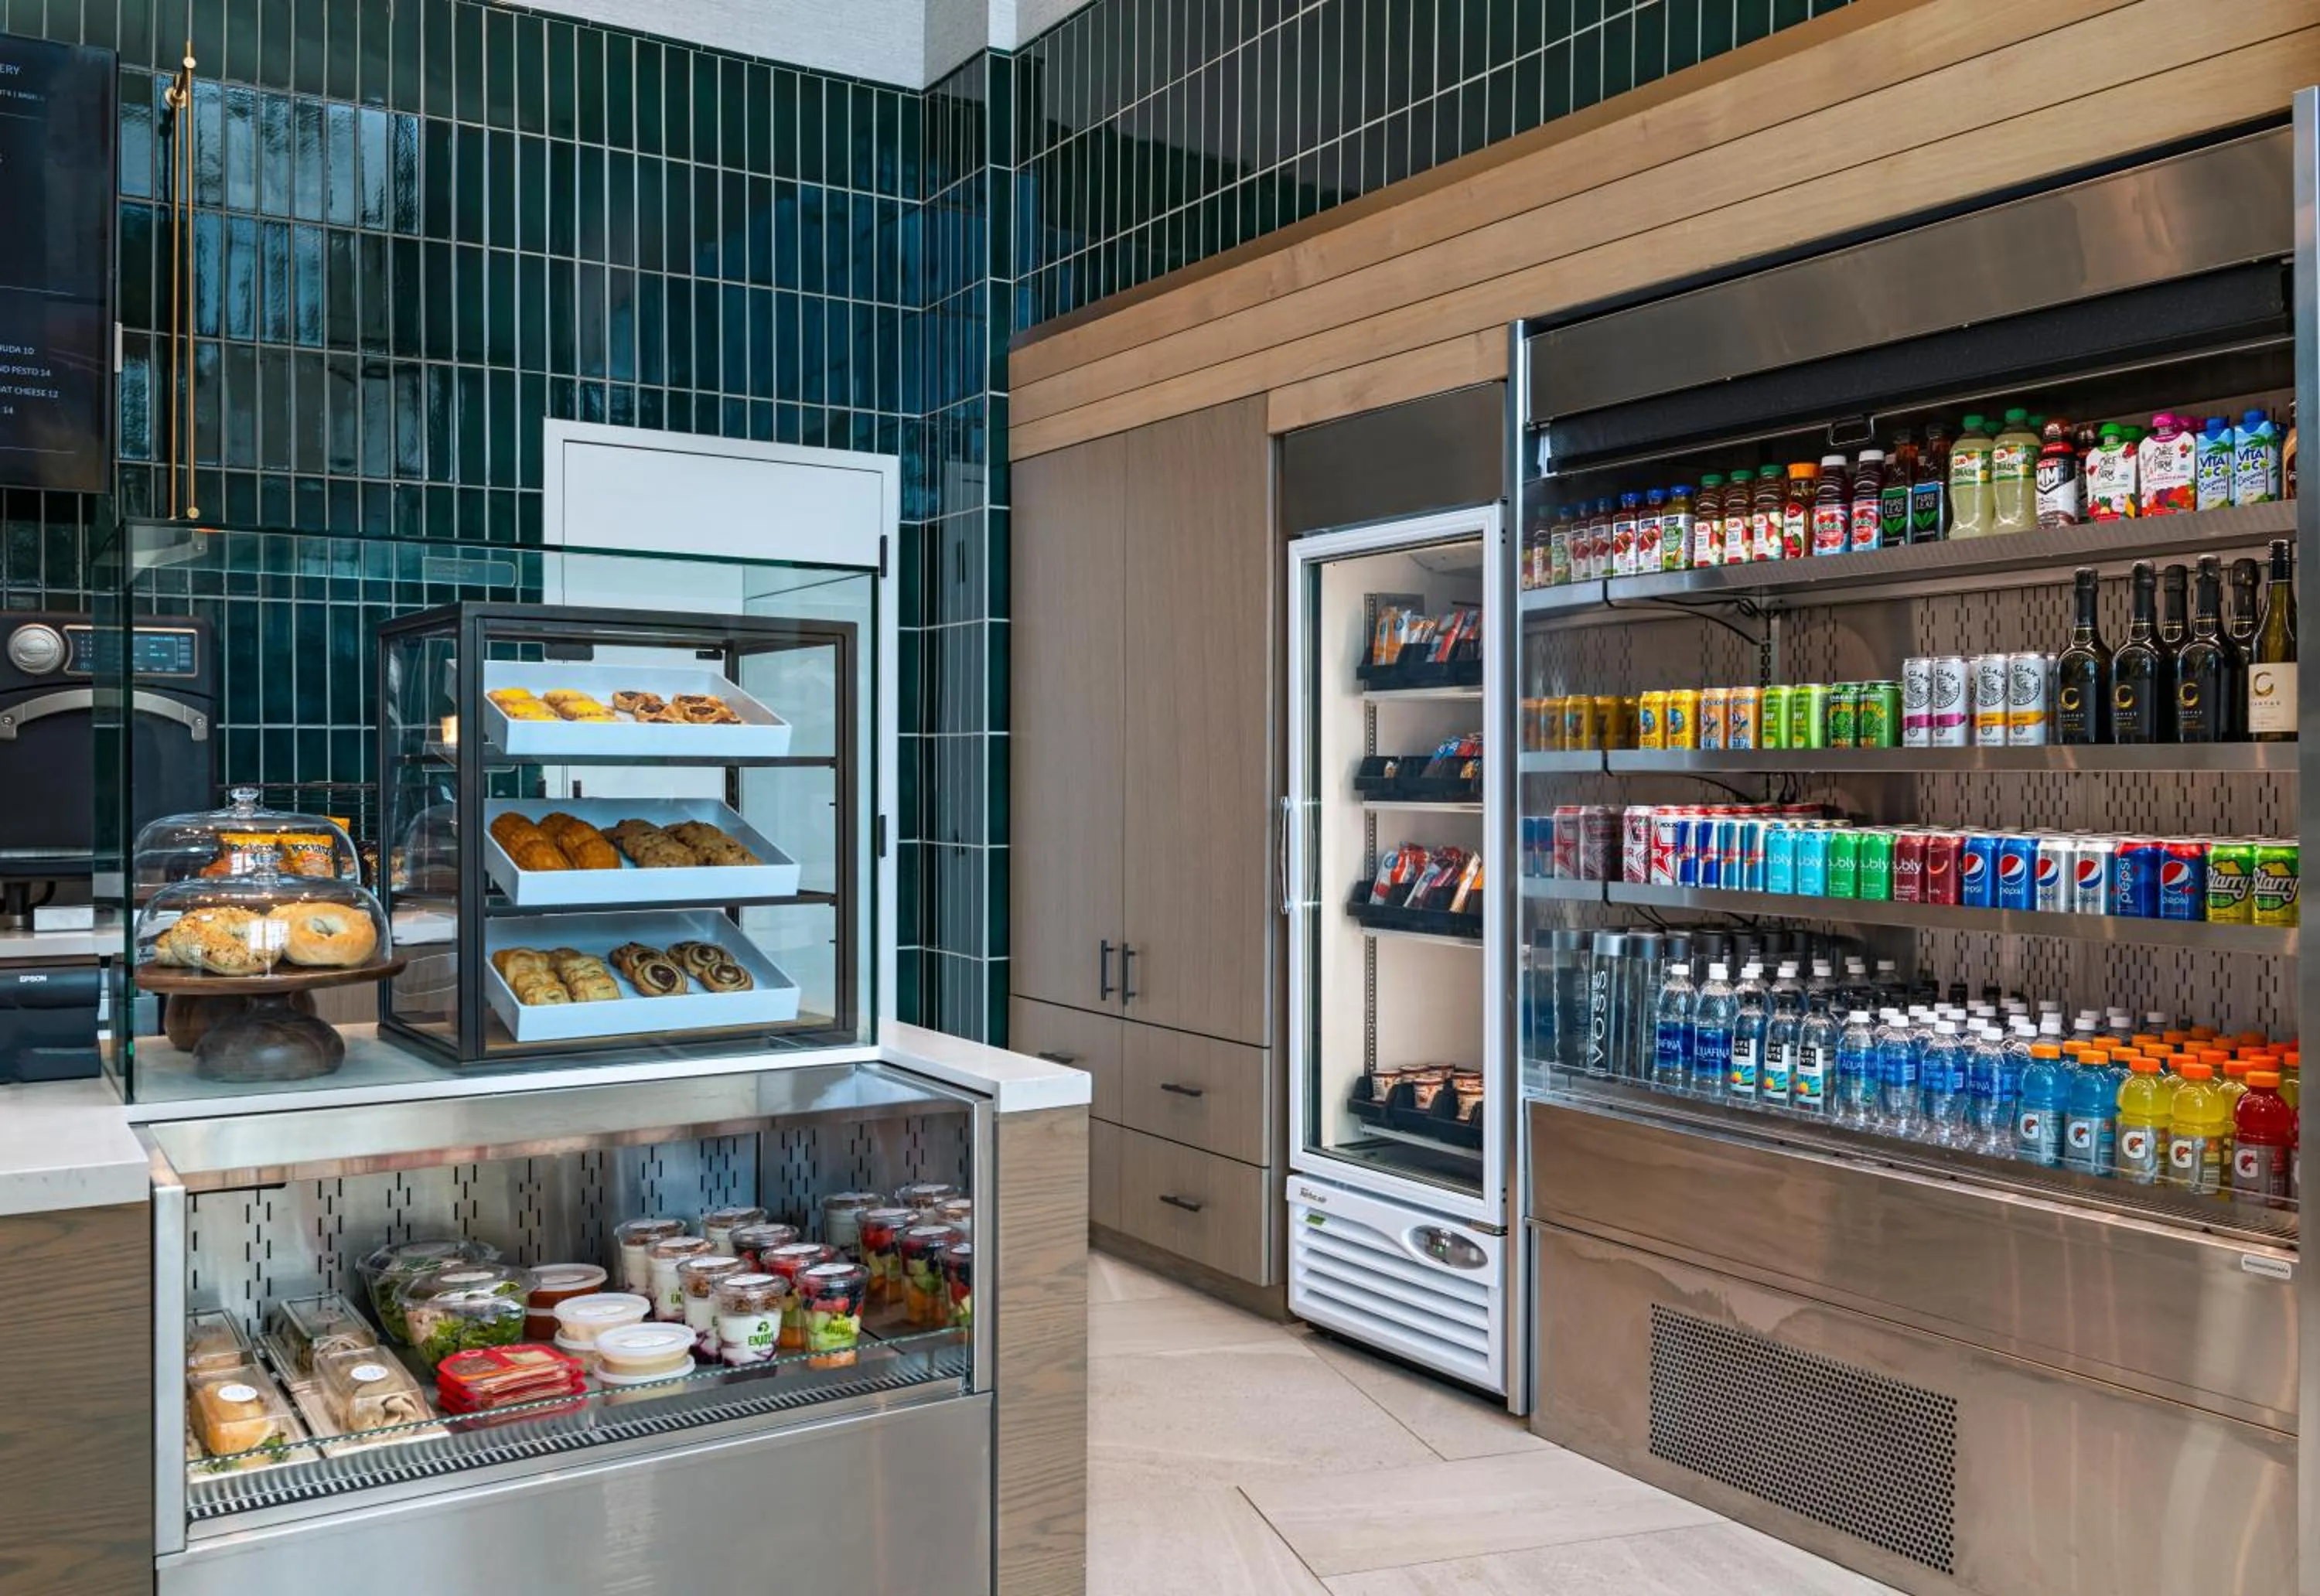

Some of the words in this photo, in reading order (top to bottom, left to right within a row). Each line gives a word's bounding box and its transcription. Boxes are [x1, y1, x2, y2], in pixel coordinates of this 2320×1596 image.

[2199, 455, 2225, 468] VITA
[2238, 448, 2264, 462] VITA
[2120, 858, 2133, 904] pepsi
[2206, 865, 2250, 901] Starry
[2252, 867, 2299, 902] Starry
[1592, 970, 1606, 1063] VOSS
